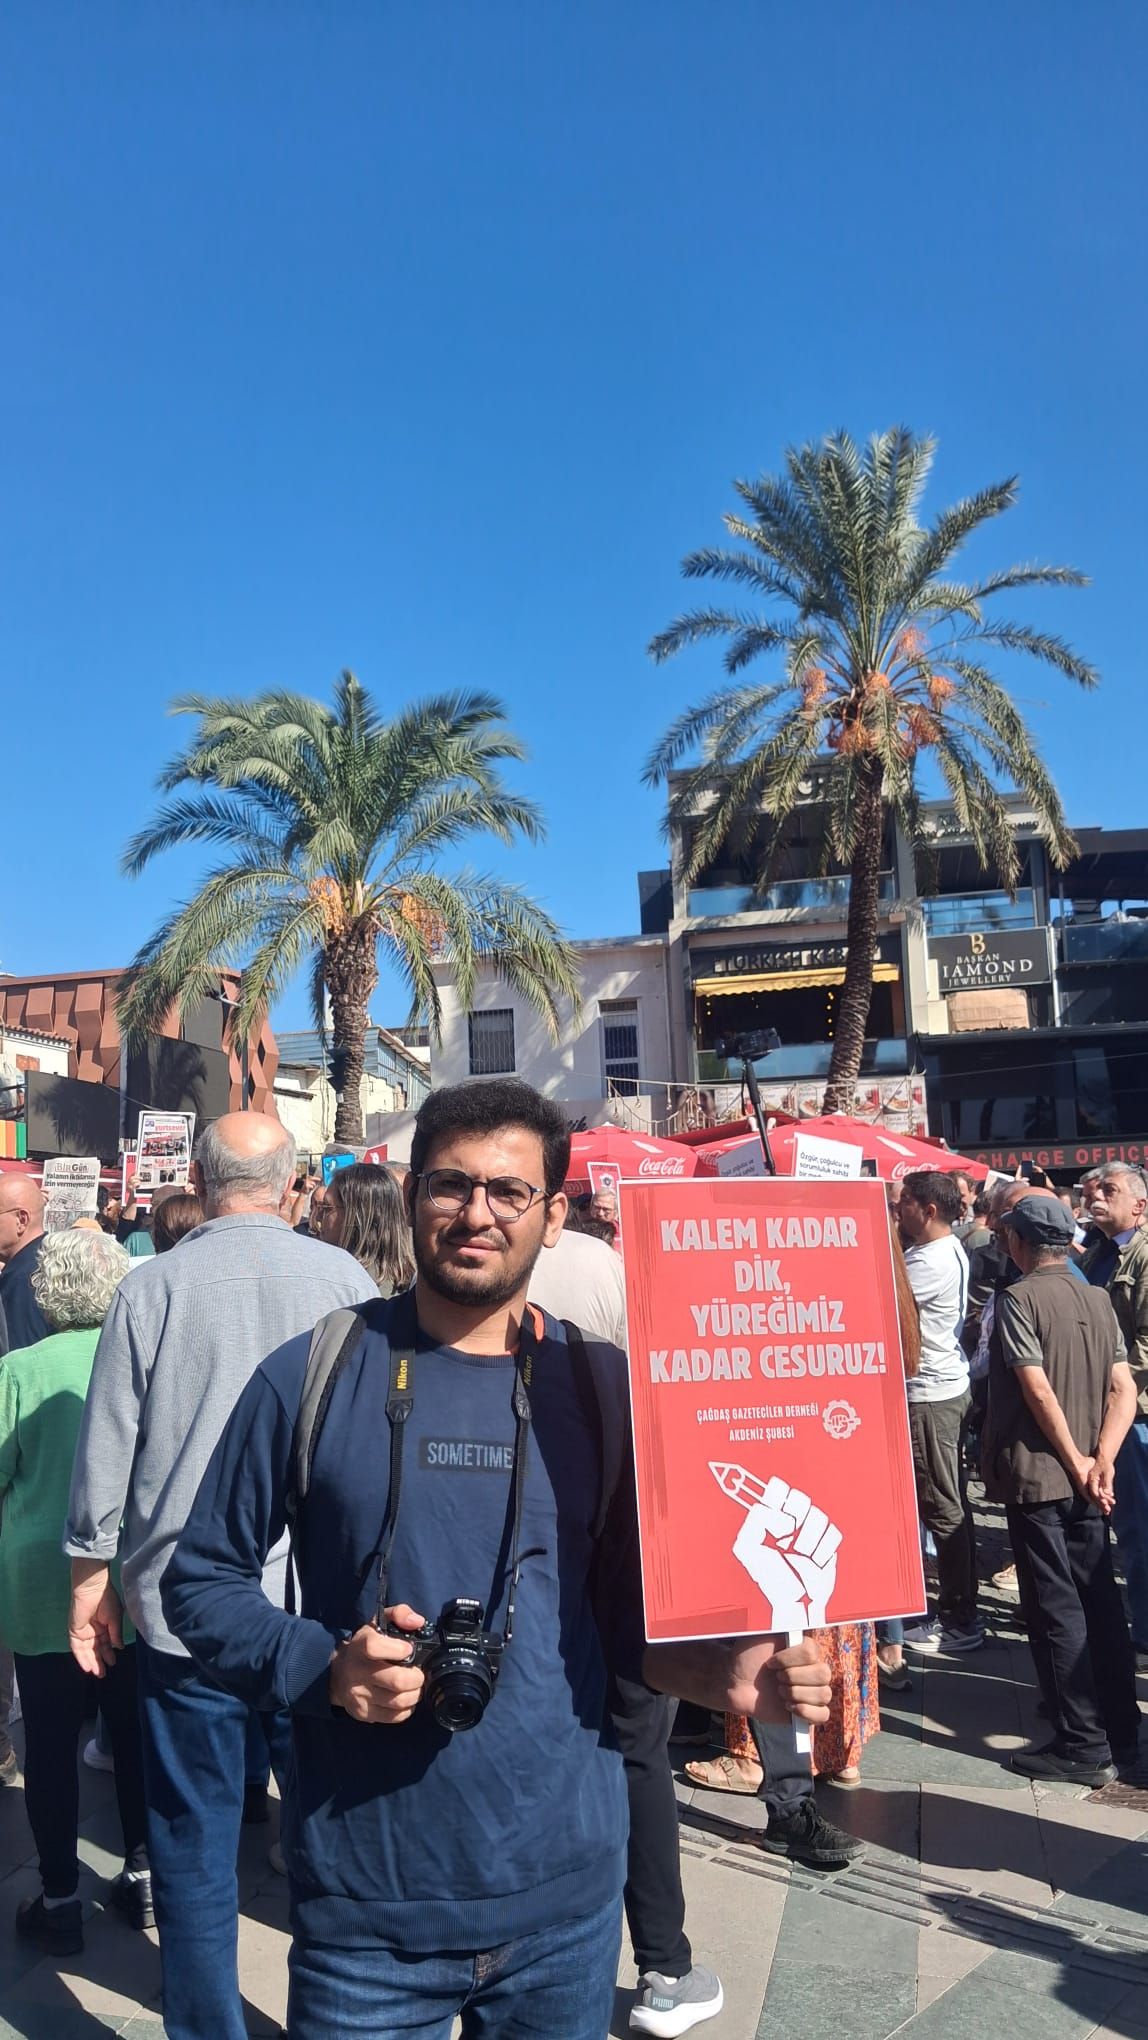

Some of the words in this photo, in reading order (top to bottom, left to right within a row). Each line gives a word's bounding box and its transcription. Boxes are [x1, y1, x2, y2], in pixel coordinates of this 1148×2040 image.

[942, 959, 1033, 978] IAMOND
[956, 953, 1000, 964] BAŞKAN
[948, 974, 1012, 987] JEWELLERY
[661, 1218, 757, 1251] KALEM
[765, 1216, 858, 1249] KADAR
[734, 1254, 791, 1294] DİK,
[690, 1295, 846, 1337] YÜREĞİMİZ
[396, 1359, 408, 1390] Nikon
[523, 1355, 532, 1386] Nikon
[650, 1346, 752, 1384] KADAR
[760, 1342, 887, 1378] CESURUZ!
[696, 1408, 730, 1425] ÇAĞDAŞ
[732, 1404, 784, 1420] GAZETECİLER
[785, 1401, 819, 1417] DERNEĞİ
[729, 1426, 765, 1442] AKDENİZ
[766, 1424, 795, 1443] ŞUBESİ
